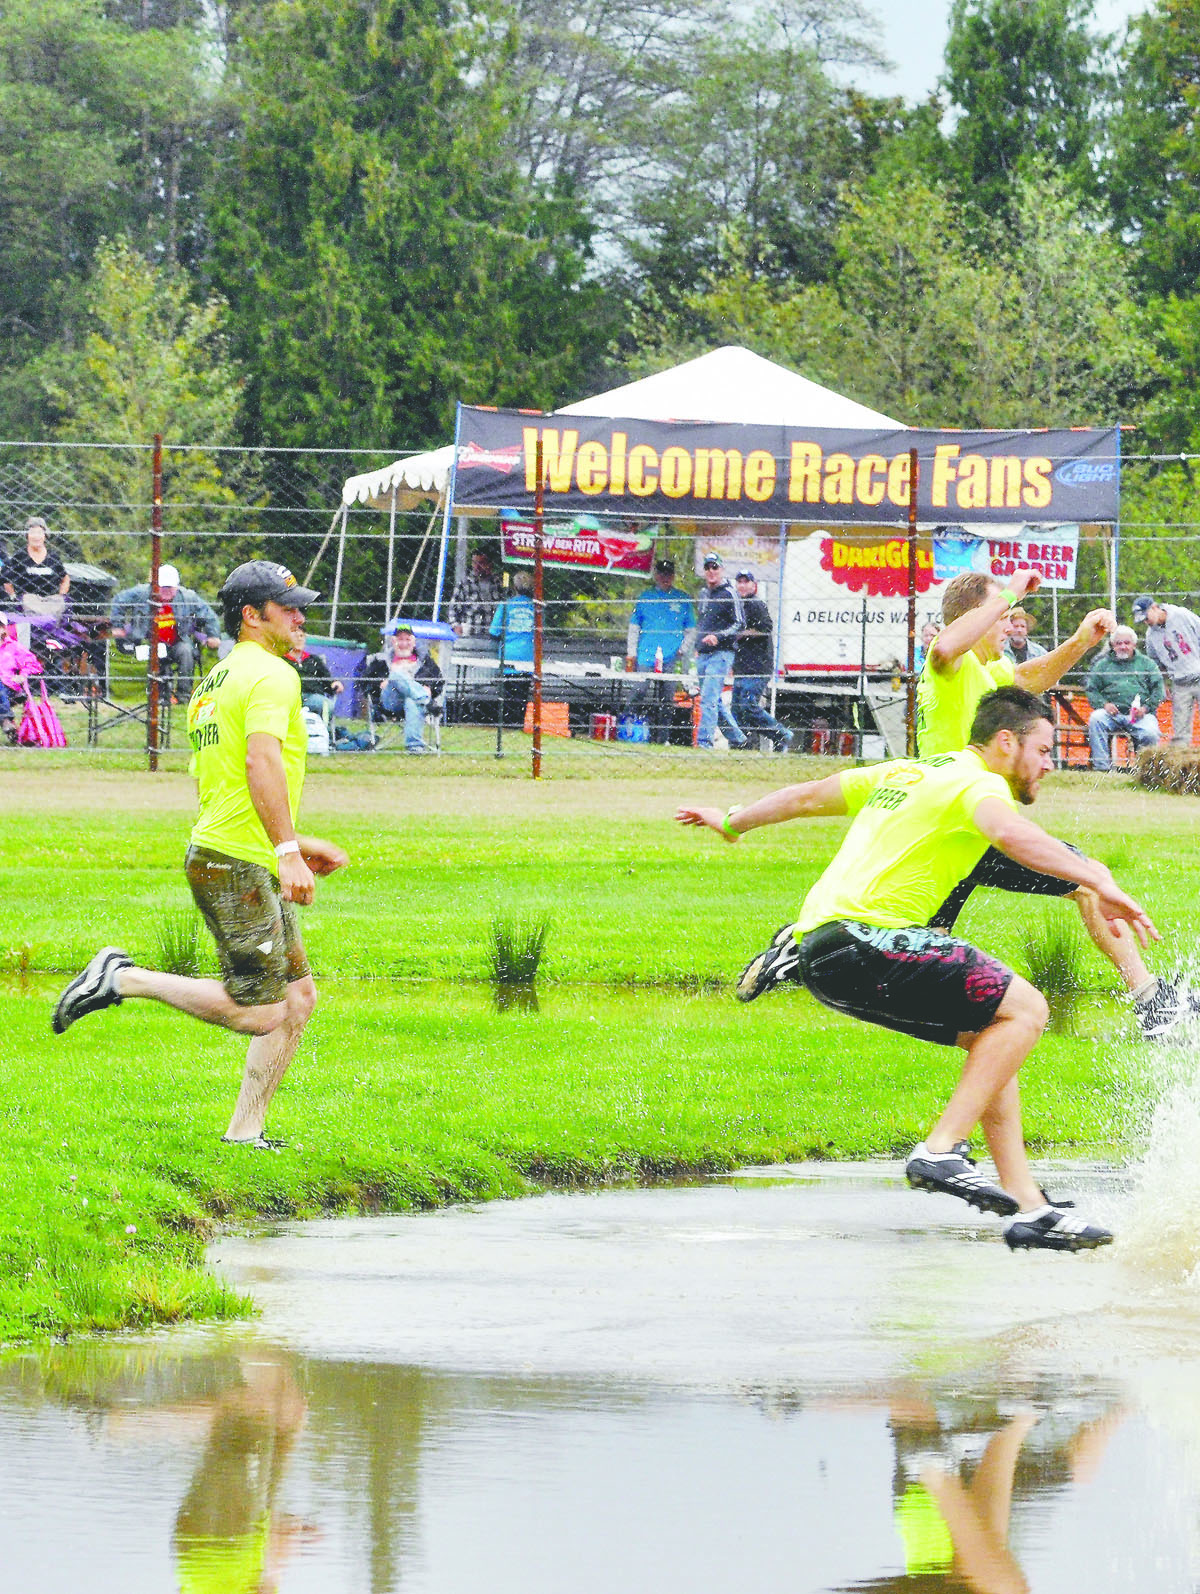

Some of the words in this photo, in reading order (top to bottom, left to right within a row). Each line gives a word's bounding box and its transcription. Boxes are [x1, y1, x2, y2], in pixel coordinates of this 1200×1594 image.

[522, 427, 776, 501] Welcome
[788, 441, 919, 506] Race
[931, 444, 1053, 508] Fans
[1073, 463, 1114, 474] BUD
[1063, 472, 1114, 483] LIGHT
[511, 532, 555, 549] STRW
[987, 539, 1022, 559] THE
[1028, 543, 1074, 563] BEER
[793, 611, 801, 624] A
[807, 610, 885, 624] DELICIOUS
[926, 612, 943, 624] TO
